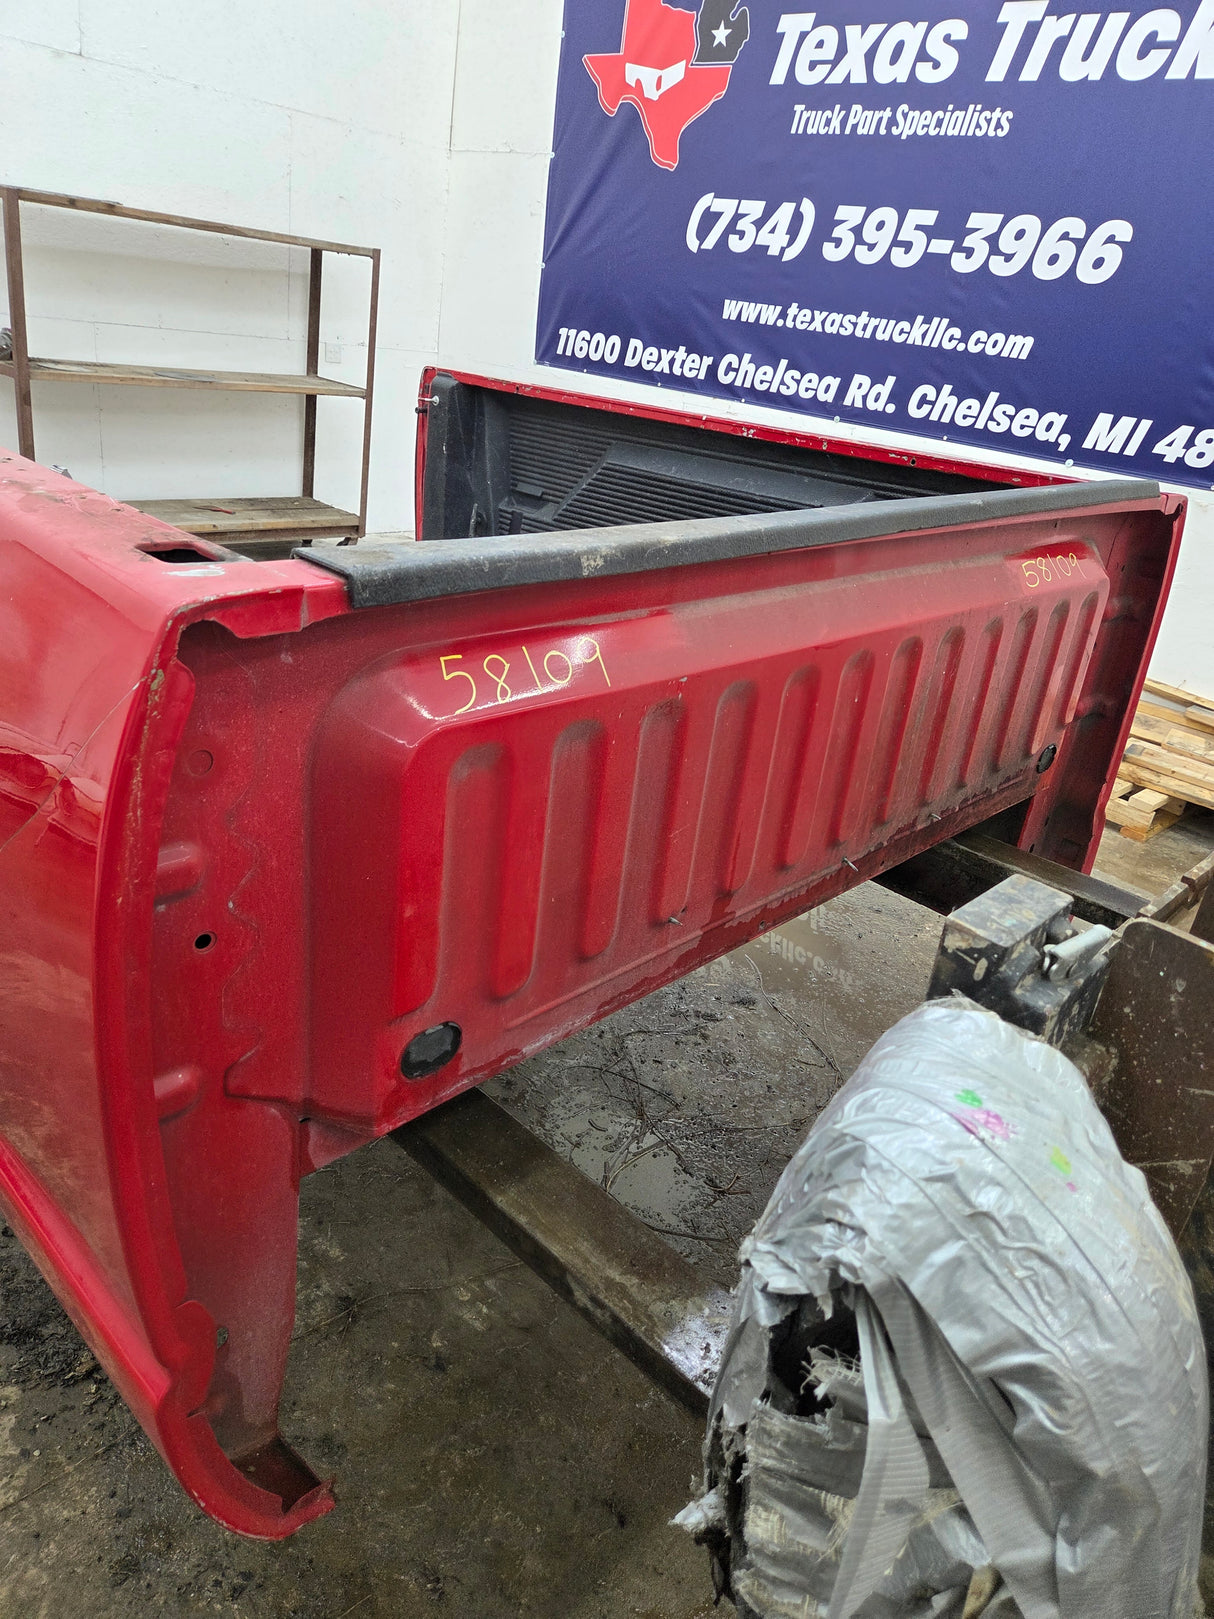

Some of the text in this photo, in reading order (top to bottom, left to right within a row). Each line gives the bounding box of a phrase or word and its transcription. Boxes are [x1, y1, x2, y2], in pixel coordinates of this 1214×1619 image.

[768, 0, 1214, 85] Texas Truck
[790, 104, 1014, 139] Truck Part Specialists
[685, 193, 1134, 285] (734) 395-3966
[722, 299, 1035, 360] www.texastruckllc.com
[556, 327, 1214, 469] 11600 Dexter Chelsea Rd. Chelsea, MI 48
[1021, 552, 1087, 588] 58109
[440, 636, 612, 715] 58109
